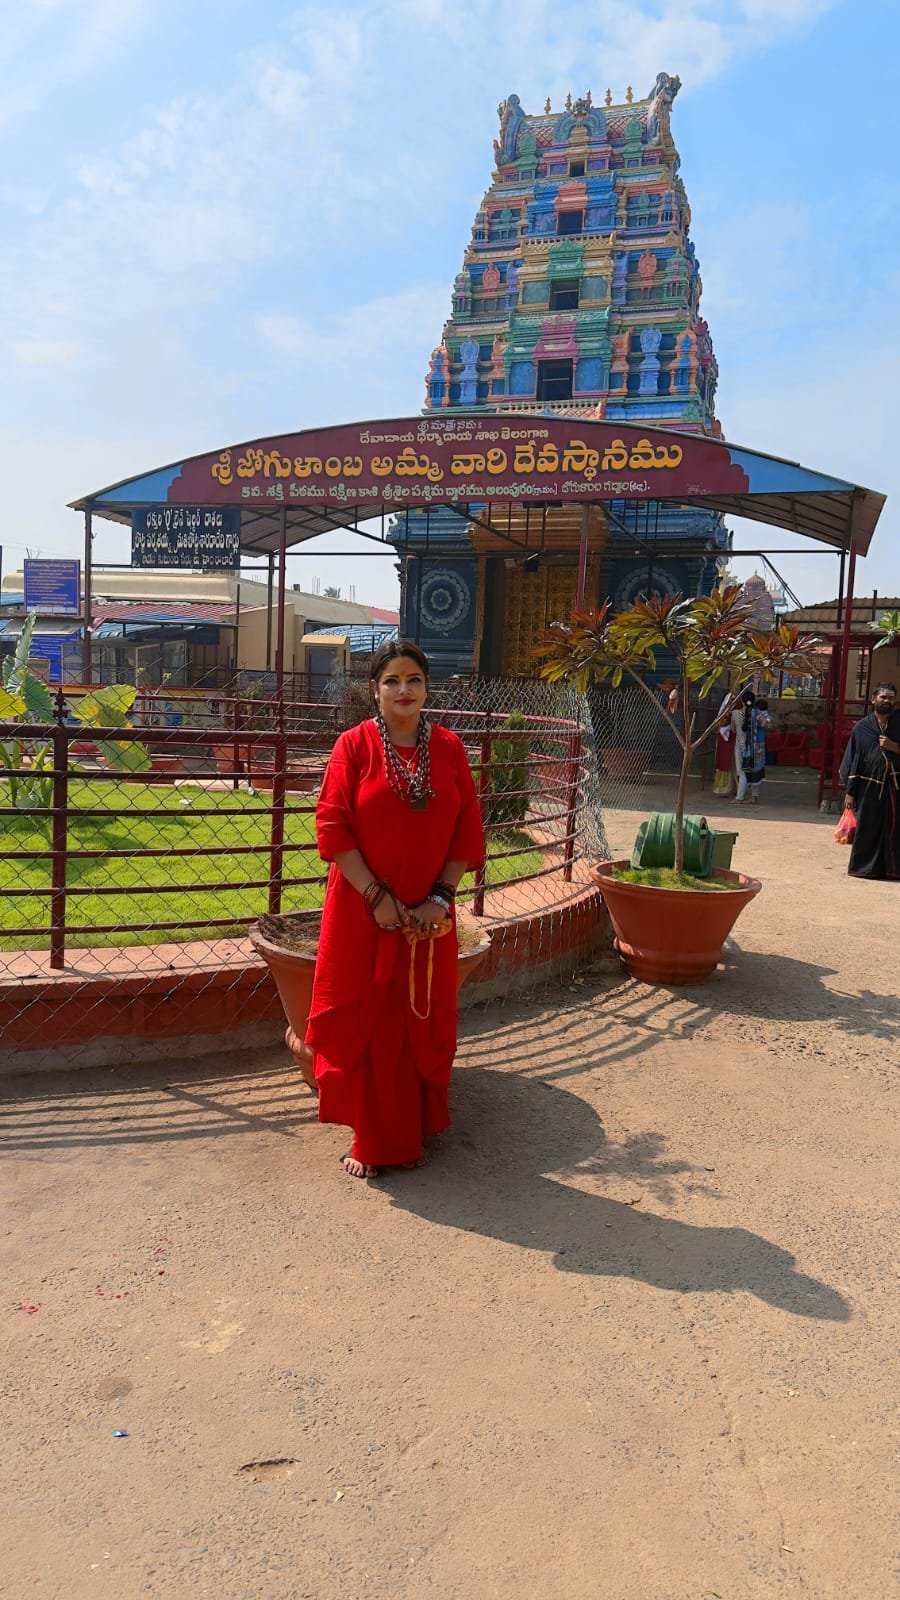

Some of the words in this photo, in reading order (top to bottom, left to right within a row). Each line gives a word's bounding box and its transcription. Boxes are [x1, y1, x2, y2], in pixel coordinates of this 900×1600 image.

[417, 420, 430, 433] శ్రీ
[360, 430, 414, 444] దేవాదాయ
[475, 431, 499, 442] శాఖ
[501, 427, 549, 440] తెలంగాణ
[211, 447, 233, 485] శ్రీ
[237, 448, 363, 479] జోగుళాంబ
[371, 447, 444, 482] అమ్మ
[450, 447, 508, 475] వారి
[513, 439, 683, 481] దేవస్థానము
